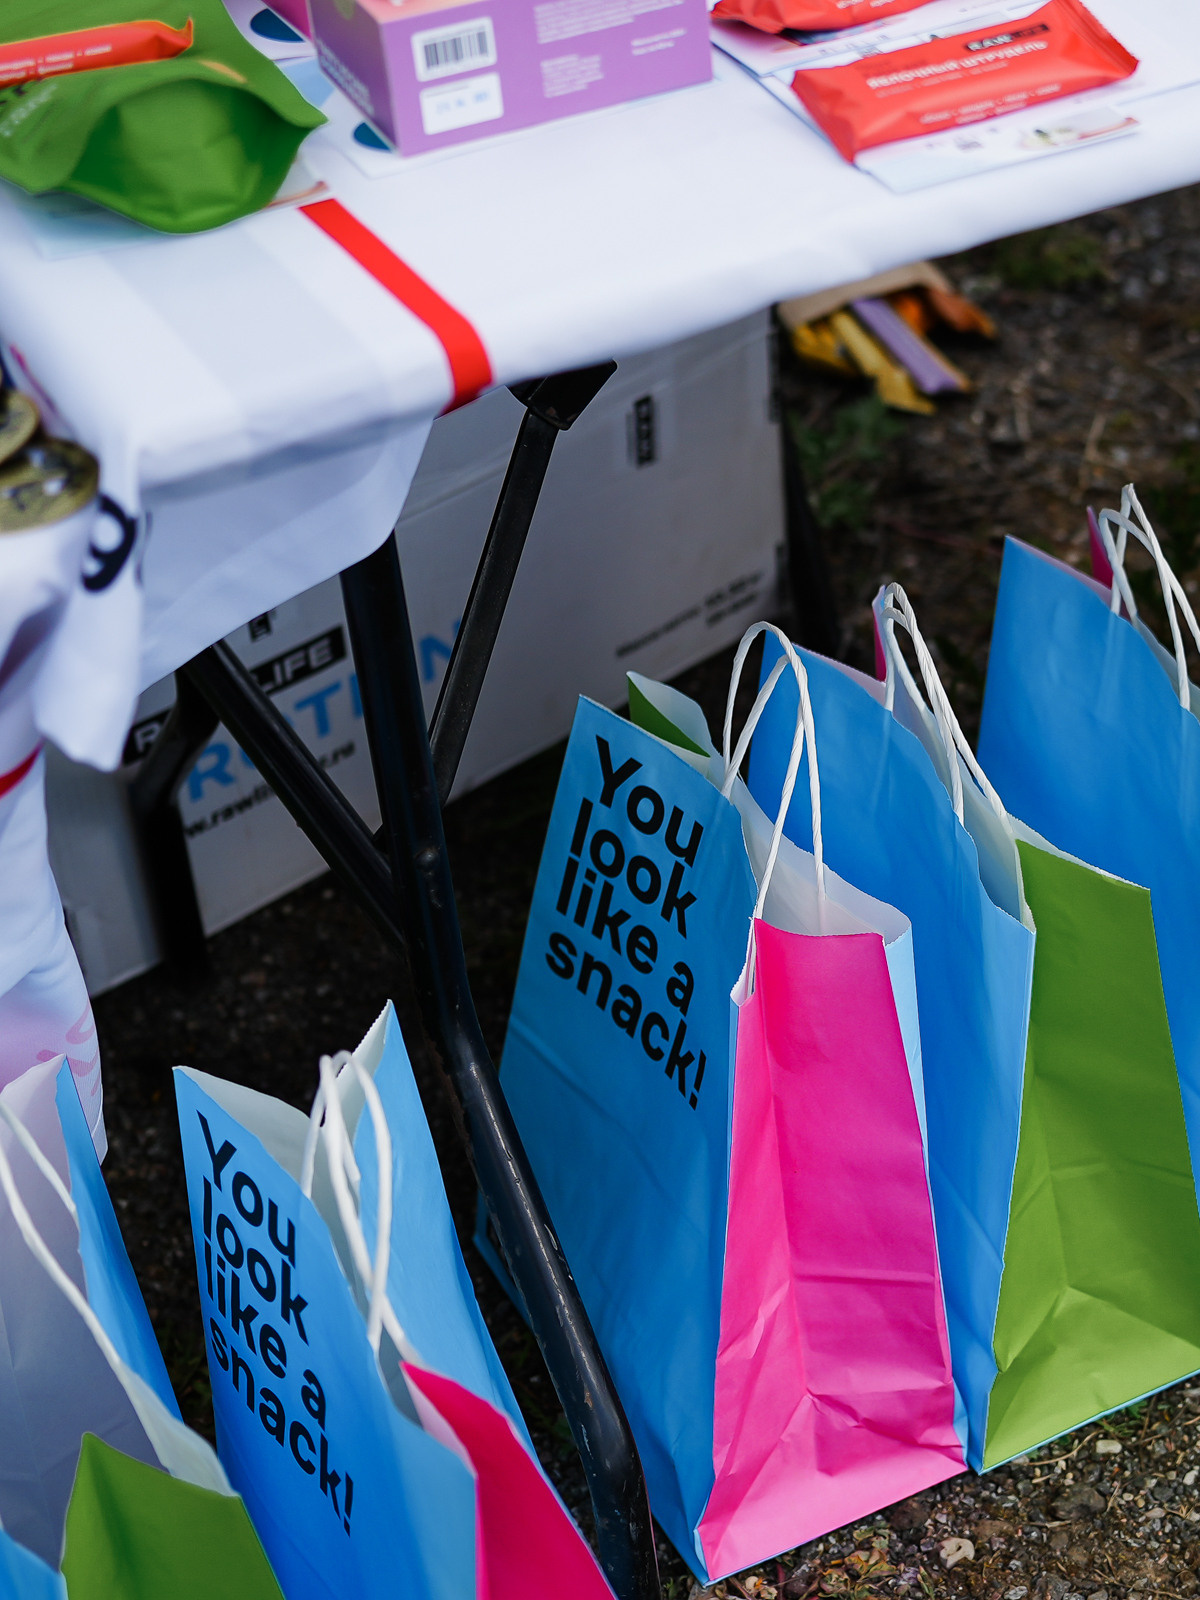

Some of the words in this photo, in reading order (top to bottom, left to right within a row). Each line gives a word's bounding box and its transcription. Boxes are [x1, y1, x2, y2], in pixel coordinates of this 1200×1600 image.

[569, 797, 697, 939] look
[595, 734, 704, 868] You
[555, 856, 659, 975] like
[665, 961, 695, 1017] a
[545, 931, 707, 1111] snack!
[197, 1110, 297, 1267] You
[203, 1177, 309, 1345] look
[205, 1239, 287, 1379] like
[301, 1369, 327, 1431] a
[209, 1317, 354, 1537] snack!
